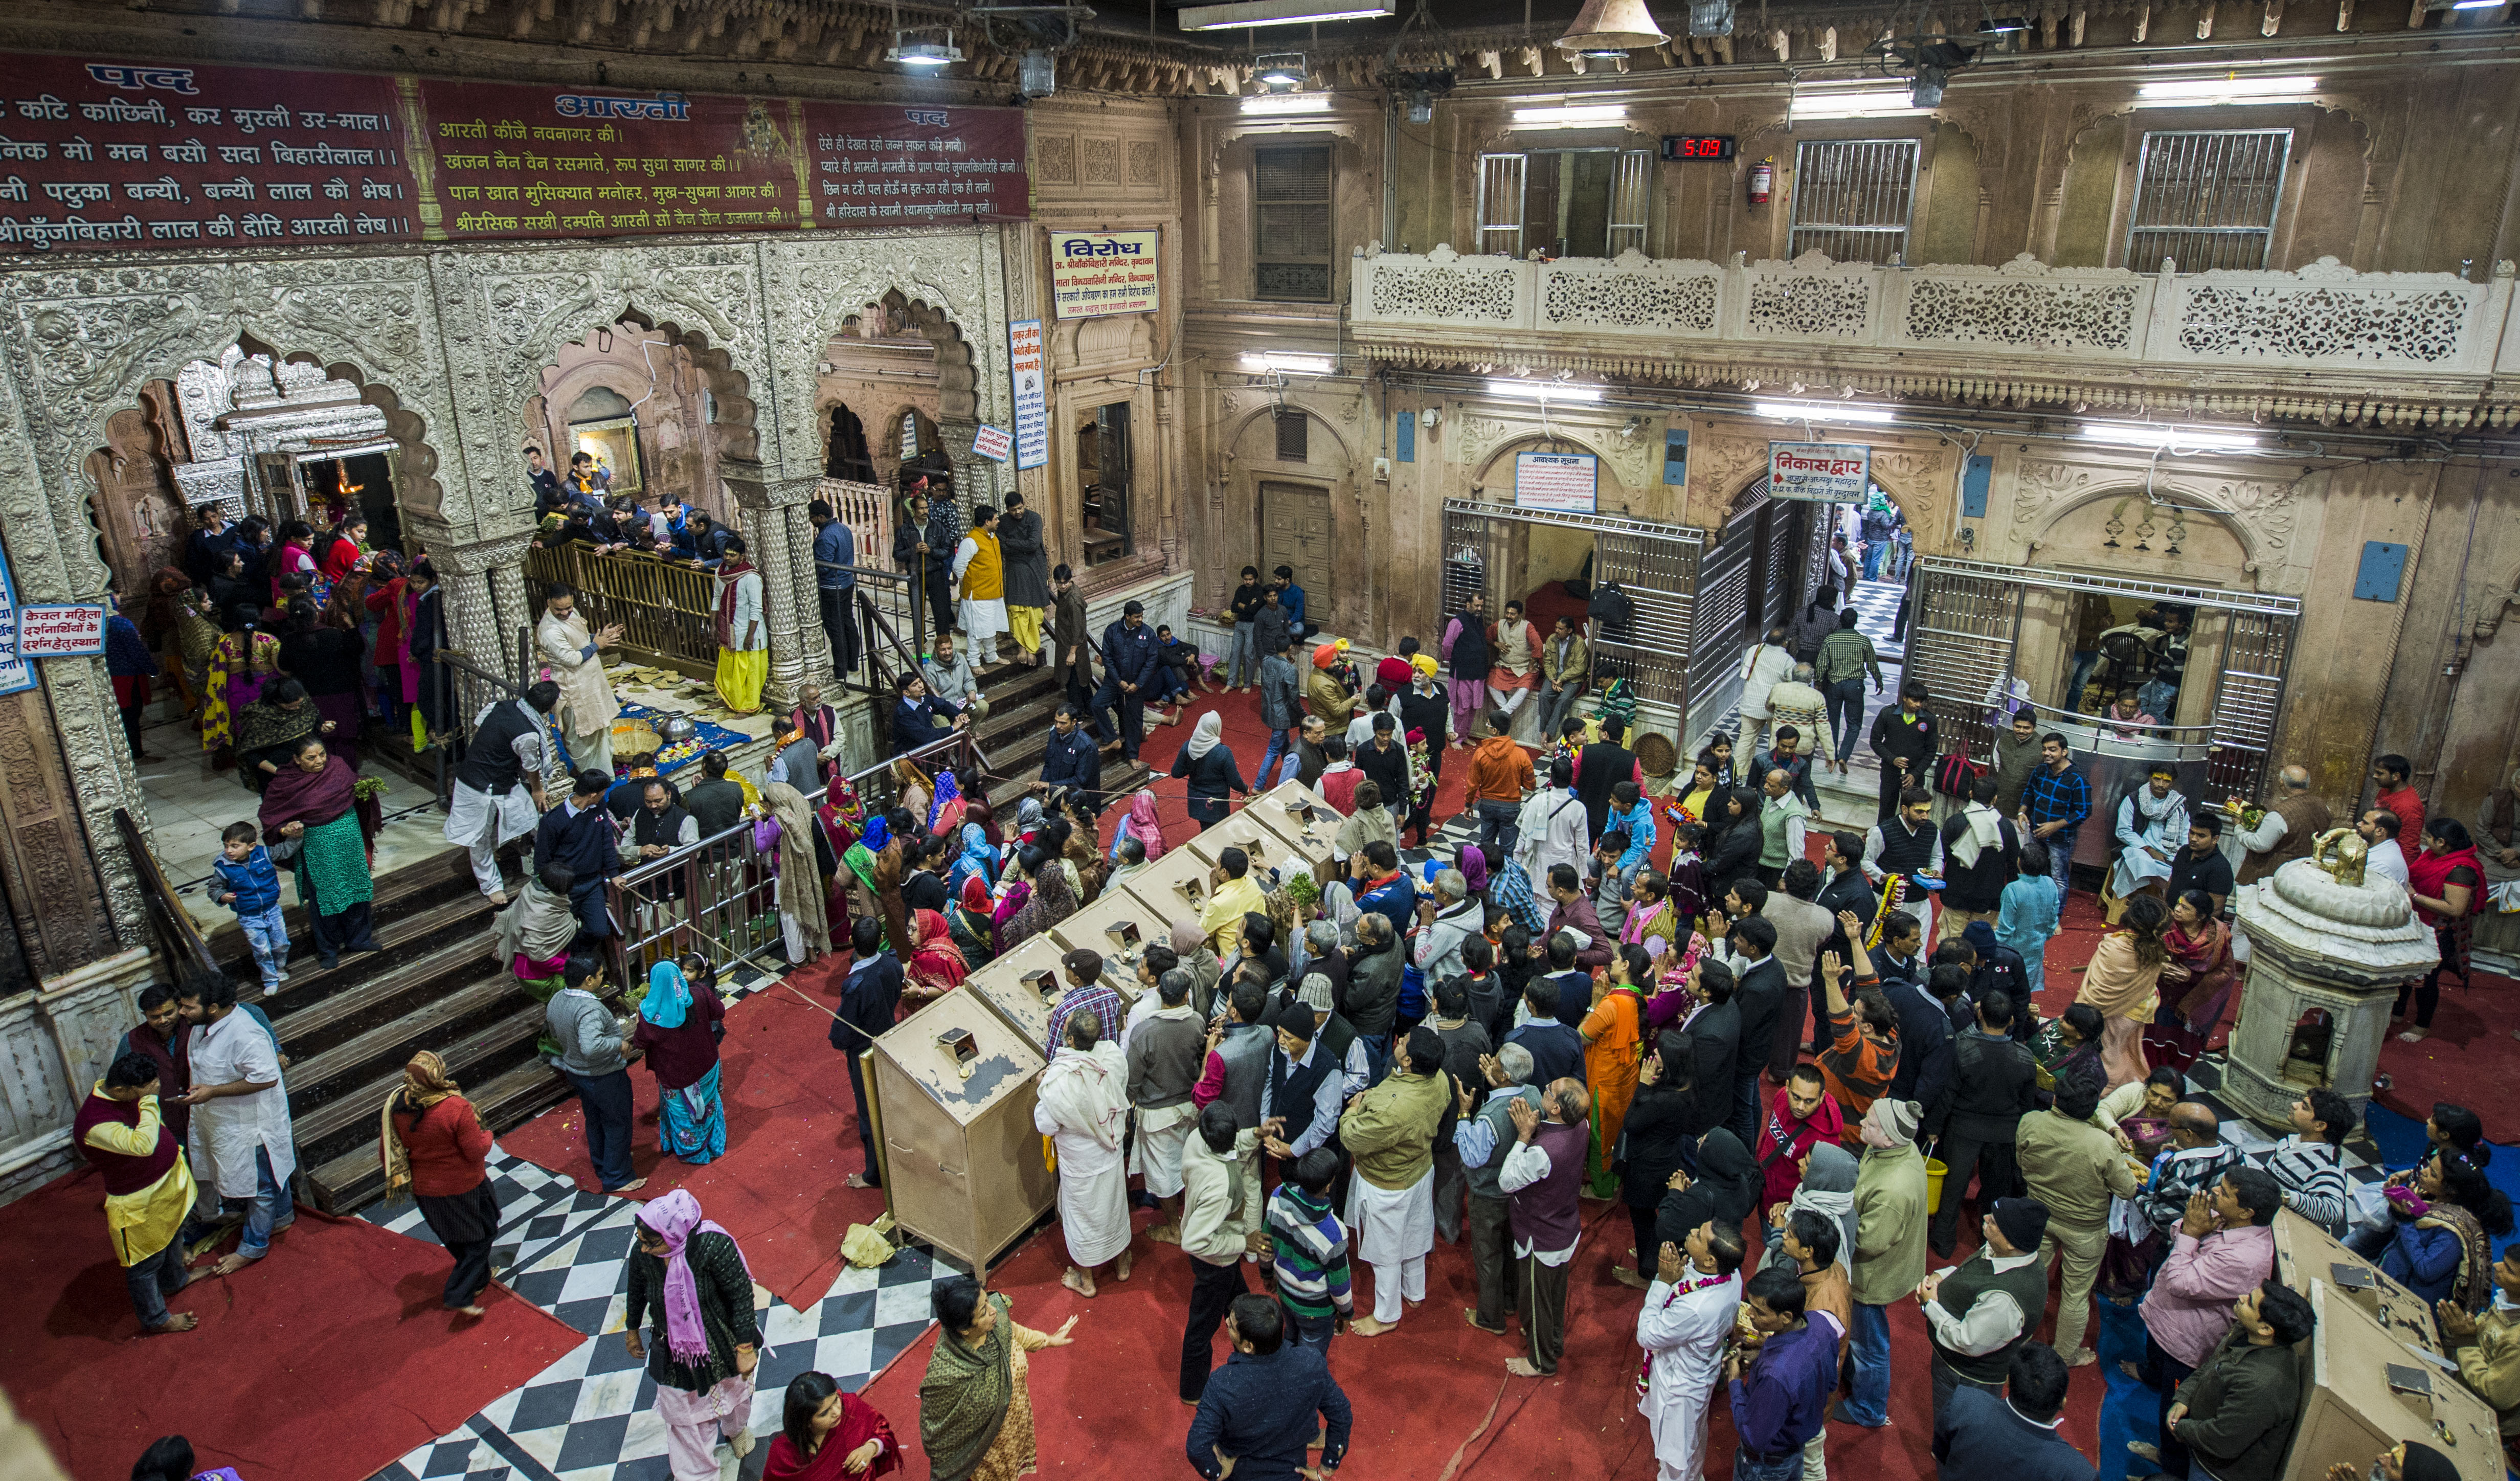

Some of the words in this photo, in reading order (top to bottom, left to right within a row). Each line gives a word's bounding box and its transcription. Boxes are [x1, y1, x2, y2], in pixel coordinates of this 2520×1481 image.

[85, 63, 199, 95] पद
[16, 94, 69, 119] कटि
[79, 97, 175, 127] काछिनी,
[185, 108, 220, 124] कर
[231, 105, 290, 133] मुरली
[555, 92, 691, 121] आरती
[905, 109, 950, 127] पद
[439, 118, 487, 138] आरती
[492, 119, 527, 140] कीजै
[531, 127, 592, 142] नवनागर
[60, 136, 93, 160] मो
[105, 144, 147, 162] मन
[160, 139, 207, 162] बसौ
[218, 146, 260, 163] सदा
[818, 133, 832, 151] ऐसे
[836, 134, 844, 151] ही
[846, 134, 867, 150] देखत
[885, 140, 903, 151] जन्म
[905, 140, 926, 151] सफल
[928, 137, 942, 151] करि
[1685, 140, 1720, 156] 5:09
[443, 150, 489, 169] खंजन
[494, 150, 520, 170] नैन
[614, 159, 637, 171] रूप
[641, 159, 668, 177] सुधा
[672, 159, 706, 171] सागर
[820, 156, 839, 172] प्यारे
[842, 157, 850, 174] ही
[853, 158, 879, 172] भामती
[882, 158, 906, 173] भामती
[908, 158, 915, 173] के
[917, 162, 932, 173] प्राण
[934, 158, 950, 173] प्यारे
[42, 184, 110, 208] पटुका
[124, 176, 190, 204] बन्यौ,
[201, 176, 255, 199] बन्यौ
[266, 184, 311, 199] लाल
[323, 177, 349, 199] कौ
[448, 186, 480, 200] पान
[484, 186, 519, 200] खात
[523, 181, 592, 206] मुसिक्यात
[597, 181, 647, 202] मनोहर,
[725, 186, 756, 198] आगर
[823, 179, 839, 195] छिन
[842, 185, 849, 195] न
[868, 184, 881, 195] पल
[883, 179, 899, 195] होऊँ
[901, 184, 907, 194] न
[910, 184, 935, 196] इत-उत
[952, 183, 963, 194] एक
[965, 179, 973, 194] ही
[826, 203, 836, 218] श्री
[838, 202, 866, 219] हरिदास
[869, 201, 876, 217] के
[879, 201, 901, 216] स्वामी
[961, 203, 973, 213] मन
[148, 221, 199, 238] लाल
[205, 214, 235, 237] की
[241, 213, 283, 236] दौरि
[291, 213, 348, 235] आरती
[456, 211, 518, 231] श्रीरसिक
[522, 211, 557, 230] सखी
[561, 210, 604, 230] दम्पति
[611, 209, 649, 228] आरती
[654, 209, 670, 227] सों
[673, 208, 696, 226] नैन
[699, 208, 721, 225] सैन
[724, 212, 764, 225] उजागर
[1062, 239, 1143, 257] विरोध
[1131, 258, 1154, 268] वृन्दावन
[1056, 279, 1070, 287] माता
[1071, 274, 1107, 286] विन्ध्यवासिनी
[1128, 272, 1155, 283] विन्ध्याचल
[1056, 289, 1061, 303] के
[1062, 288, 1079, 302] सरकारी
[1082, 287, 1100, 301] अधिग्रहण
[1102, 290, 1108, 299] का
[1109, 289, 1116, 299] हम
[1118, 285, 1127, 297] सभी
[1128, 284, 1140, 297] विरोध
[1141, 283, 1151, 296] करते
[1012, 331, 1024, 343] ठाकुर
[1025, 327, 1031, 339] जी
[1014, 344, 1024, 356] फोटो
[1025, 343, 1040, 356] खींचना
[1025, 361, 1034, 370] मना
[982, 427, 995, 436] केवल
[1561, 457, 1580, 466] सूचना
[1774, 451, 1831, 471] निकास
[1830, 459, 1862, 476] द्वार
[1835, 476, 1858, 488] महोदय
[1826, 487, 1832, 496] जी
[1834, 490, 1860, 500] वृन्दावन
[26, 610, 61, 620] केवल
[65, 608, 101, 621] महिला
[87, 622, 98, 632] के
[23, 638, 52, 651] दर्शन
[52, 637, 71, 650] हेतु
[72, 638, 101, 646] स्थान
